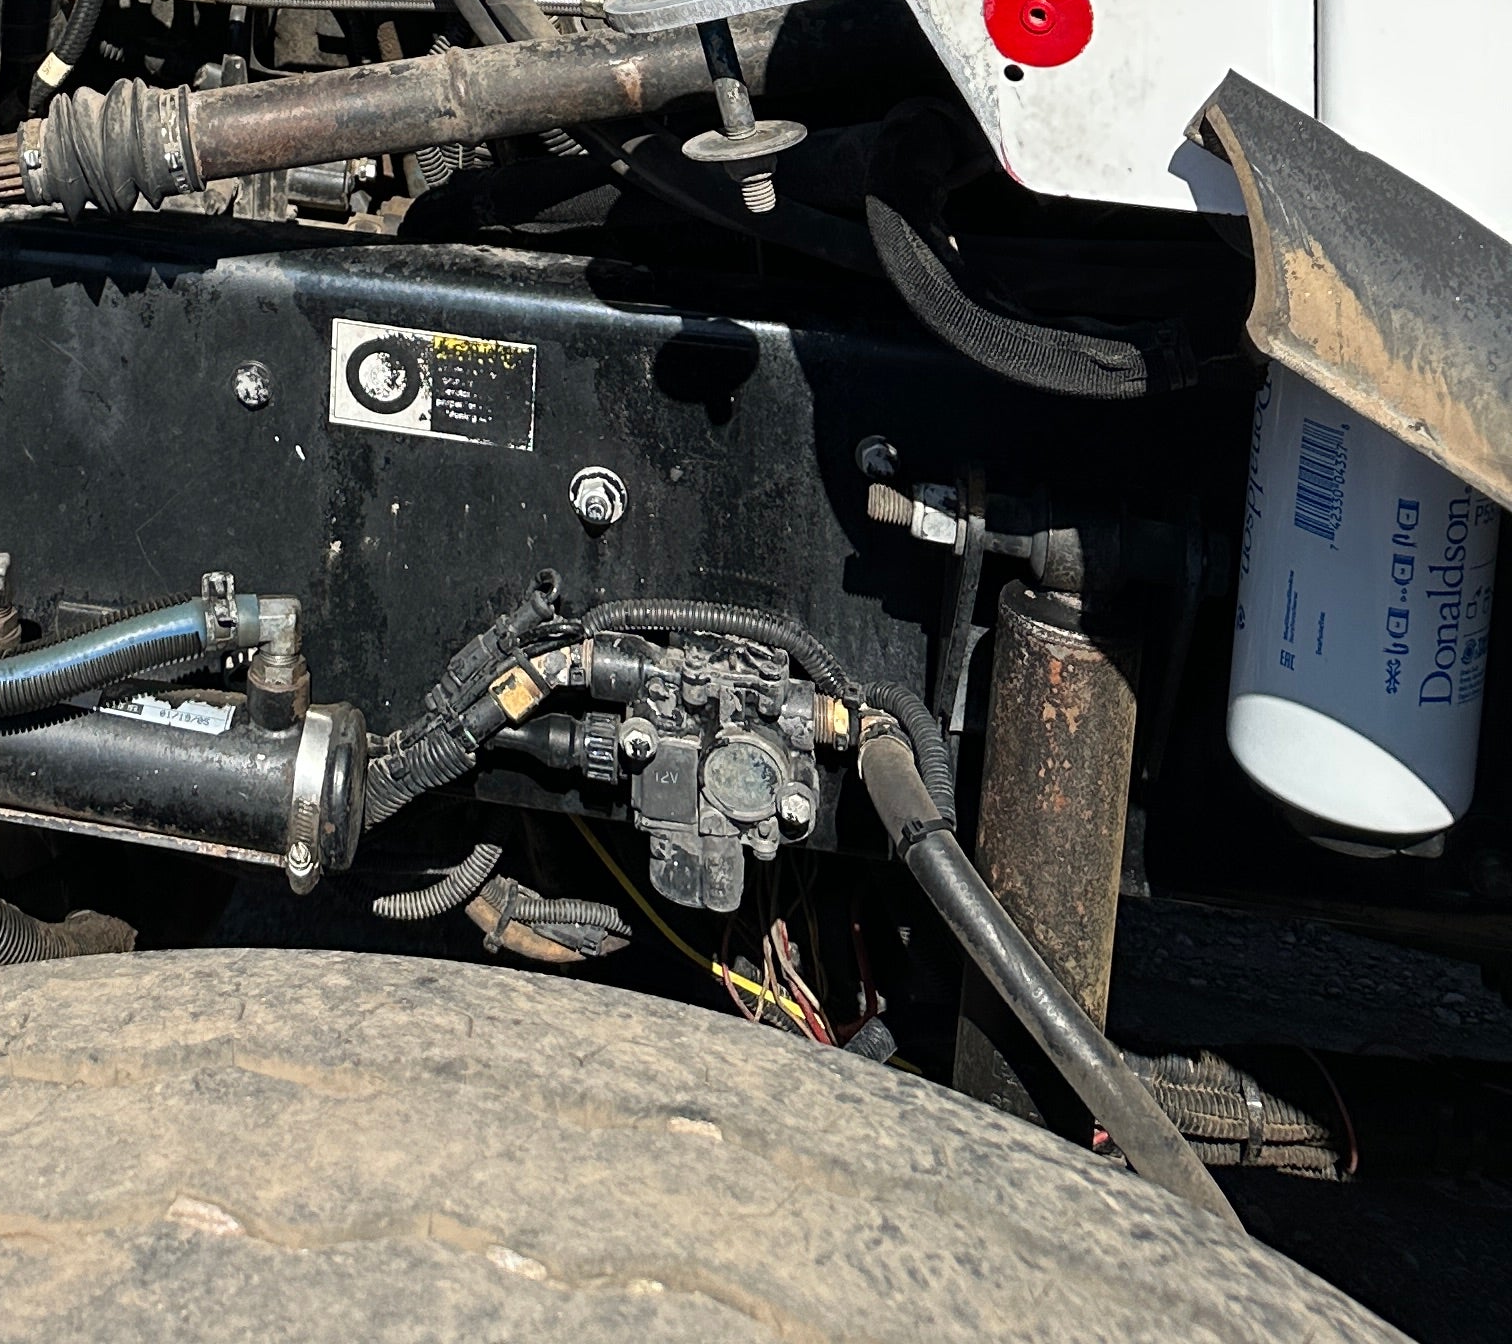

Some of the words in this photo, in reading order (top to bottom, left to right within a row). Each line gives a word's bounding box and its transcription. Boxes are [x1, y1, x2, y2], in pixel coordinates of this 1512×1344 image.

[1333, 443, 1348, 485] 04357
[1330, 488, 1344, 530] 42330
[654, 769, 680, 785] 12V
